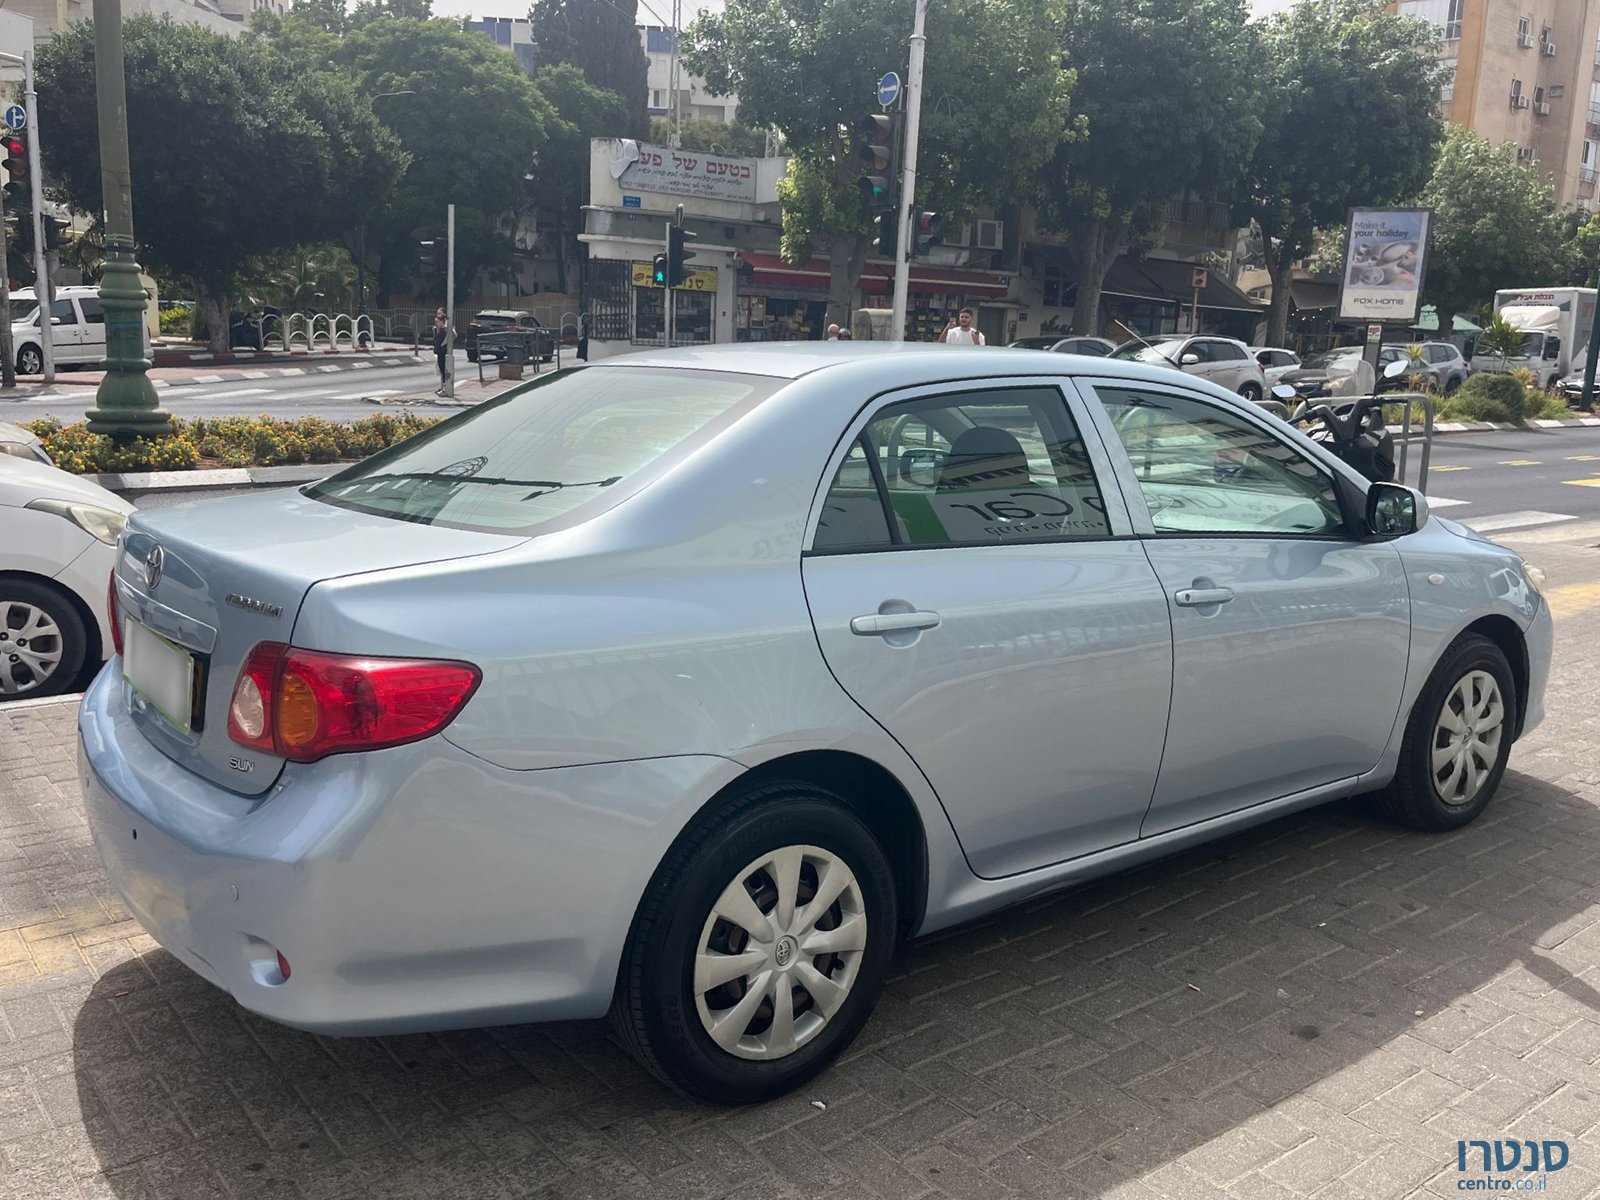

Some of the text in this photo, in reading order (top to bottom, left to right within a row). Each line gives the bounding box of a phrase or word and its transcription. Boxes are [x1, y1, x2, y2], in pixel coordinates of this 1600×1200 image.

[638, 152, 663, 167] פע
[672, 152, 697, 171] של
[706, 160, 751, 179] בטעם
[1355, 221, 1379, 229] Make
[1354, 229, 1409, 239] your holiday
[1375, 298, 1405, 306] HOME
[229, 755, 256, 773] SUN
